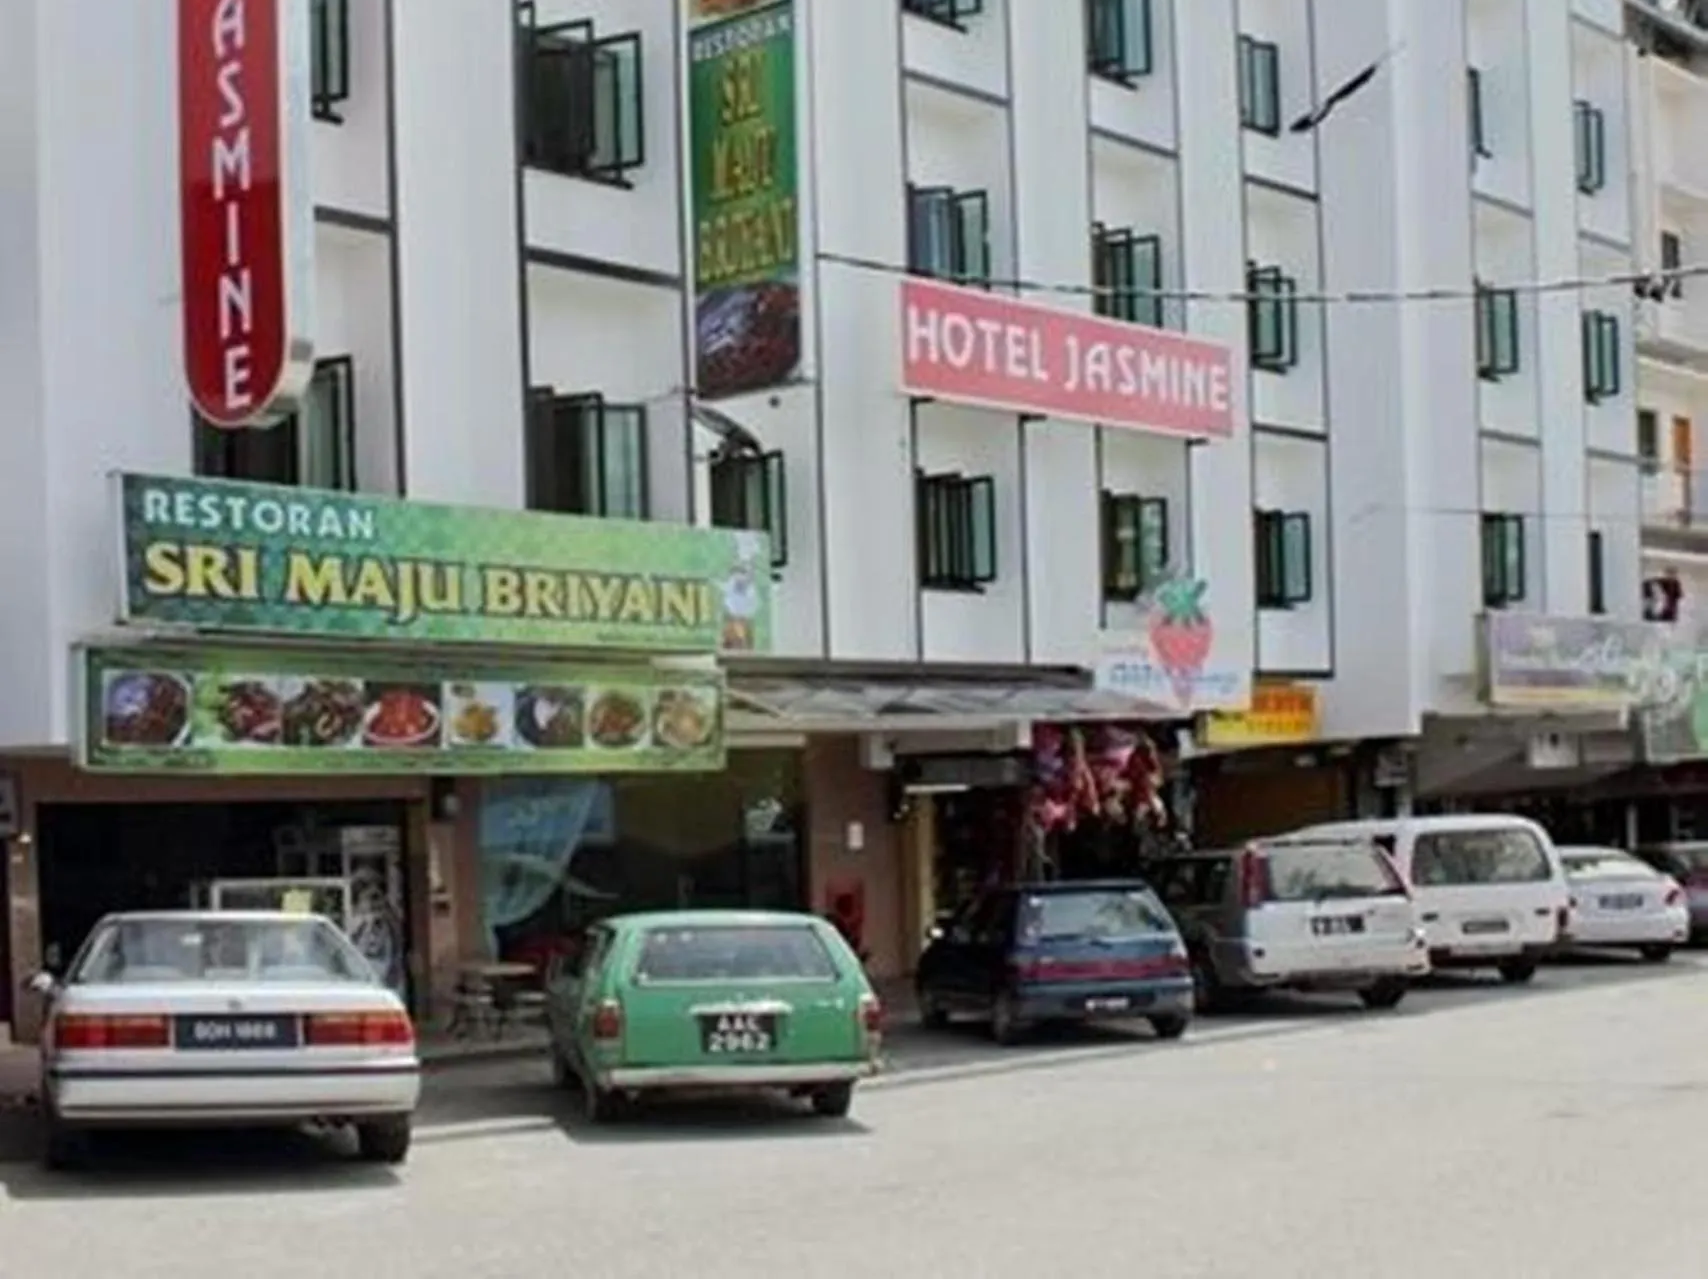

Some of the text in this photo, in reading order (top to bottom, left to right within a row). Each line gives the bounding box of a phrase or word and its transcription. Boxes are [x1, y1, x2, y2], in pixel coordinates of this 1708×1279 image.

[907, 305, 1228, 410] HOTEL JASMINE
[144, 489, 375, 539] RESTORAN
[144, 540, 713, 627] SRI MAJU BRIYANI
